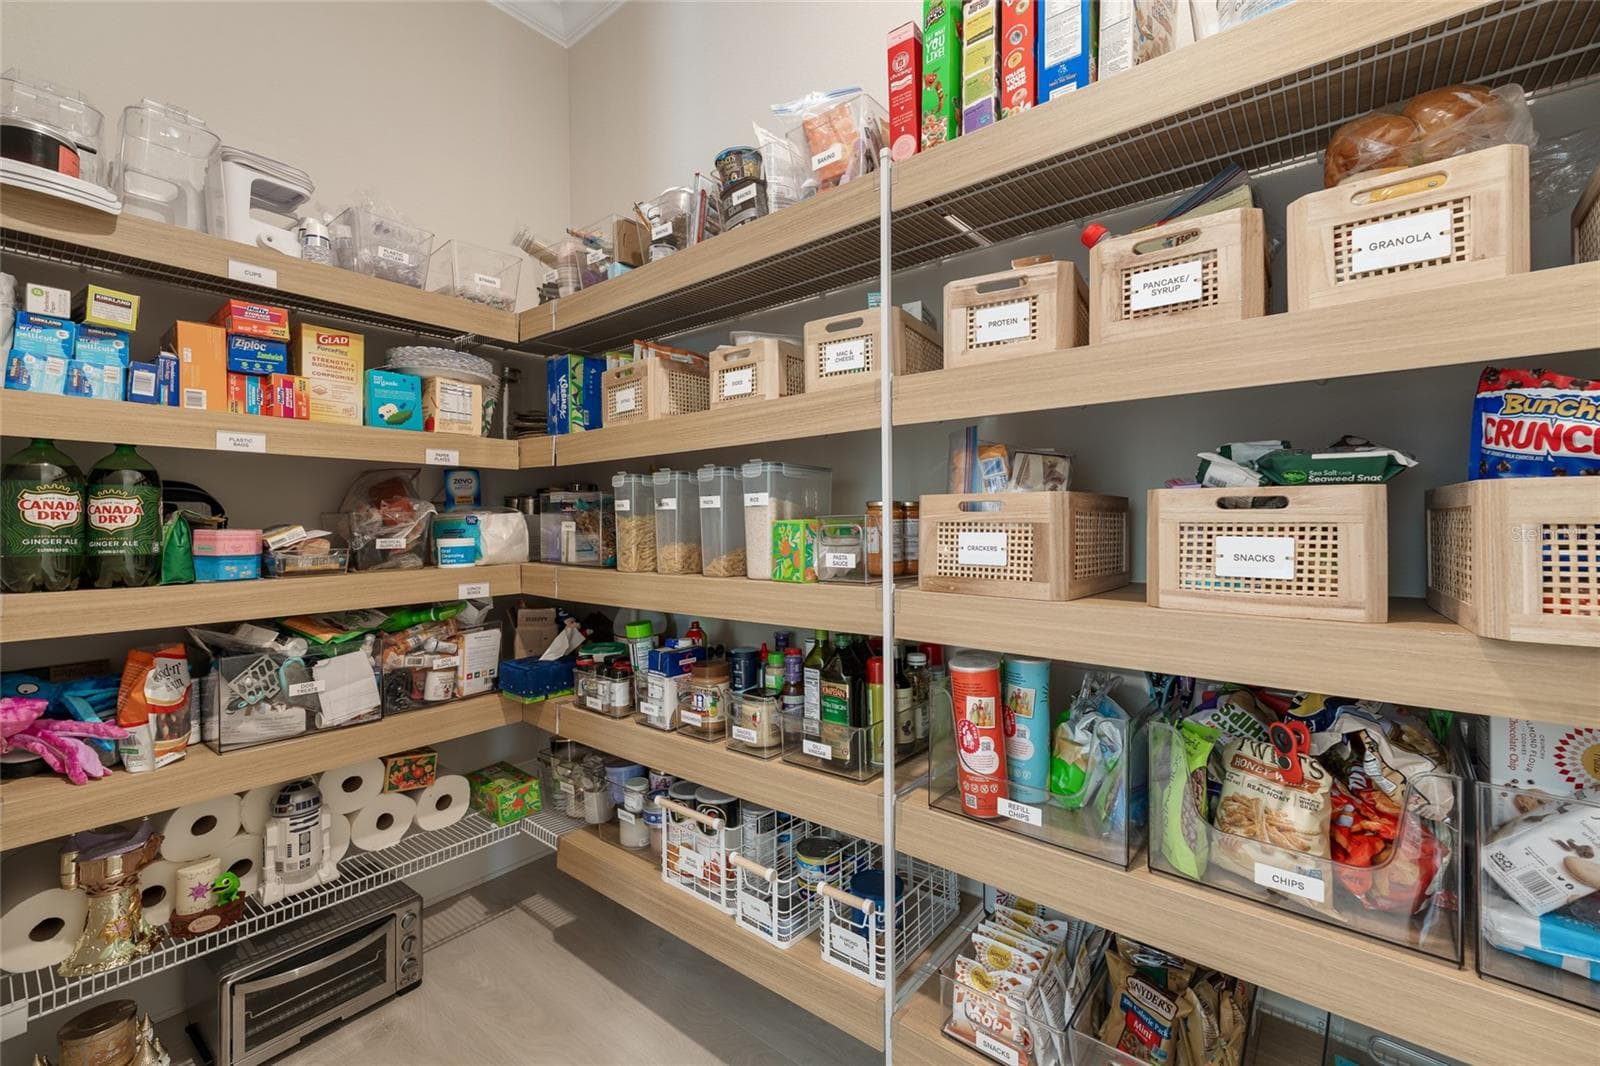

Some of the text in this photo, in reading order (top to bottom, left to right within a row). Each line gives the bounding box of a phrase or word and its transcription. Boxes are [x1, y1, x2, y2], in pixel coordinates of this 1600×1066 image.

[926, 33, 945, 53] YOU
[817, 152, 836, 165] BAKING
[1366, 233, 1408, 248] GRANOLA
[383, 248, 403, 257] PLASTIC
[244, 270, 262, 278] CUPS
[1142, 274, 1191, 291] PANCAKE/
[1151, 284, 1181, 297] SYRUP
[96, 294, 131, 307] KIRKLAND
[29, 316, 63, 327] KIRKLAND
[988, 316, 1018, 329] PROTEIN
[18, 324, 42, 334] wrap
[88, 328, 118, 338] KIRKLAND
[235, 338, 267, 352] Ziploc
[319, 335, 348, 344] GLAD
[835, 355, 855, 363] CHEESE
[836, 349, 848, 358] MAC
[312, 356, 349, 367] STRENGTH
[312, 362, 354, 372] SUSTAINABILITY
[311, 371, 354, 382] COMPROMISE
[229, 436, 253, 444] PLASTIC
[1308, 474, 1356, 483] Seaweed
[1324, 469, 1337, 477] Salt
[18, 499, 82, 513] CANADA
[87, 504, 144, 516] CANADA
[37, 511, 71, 521] DRY
[98, 515, 128, 524] DRY
[967, 544, 998, 553] CRACKERS
[1233, 552, 1276, 564] SNACKS
[1507, 718, 1519, 771] hocolate Chip
[1237, 736, 1324, 780] TWTS
[1525, 749, 1538, 773] FLOUR
[1234, 756, 1272, 777] HONEY
[1246, 783, 1290, 804] REAL HONEY
[1007, 802, 1031, 815] REFILL
[1299, 799, 1320, 810] WHOLE
[1008, 810, 1031, 823] CHIPS
[1272, 873, 1305, 891] CHIPS
[1129, 979, 1174, 1015] SNYDER'S
[1133, 1005, 1154, 1027] Calorie
[1154, 1024, 1170, 1038] Pack
[1133, 1020, 1153, 1040] Mini
[982, 1039, 1011, 1060] SNACKS
